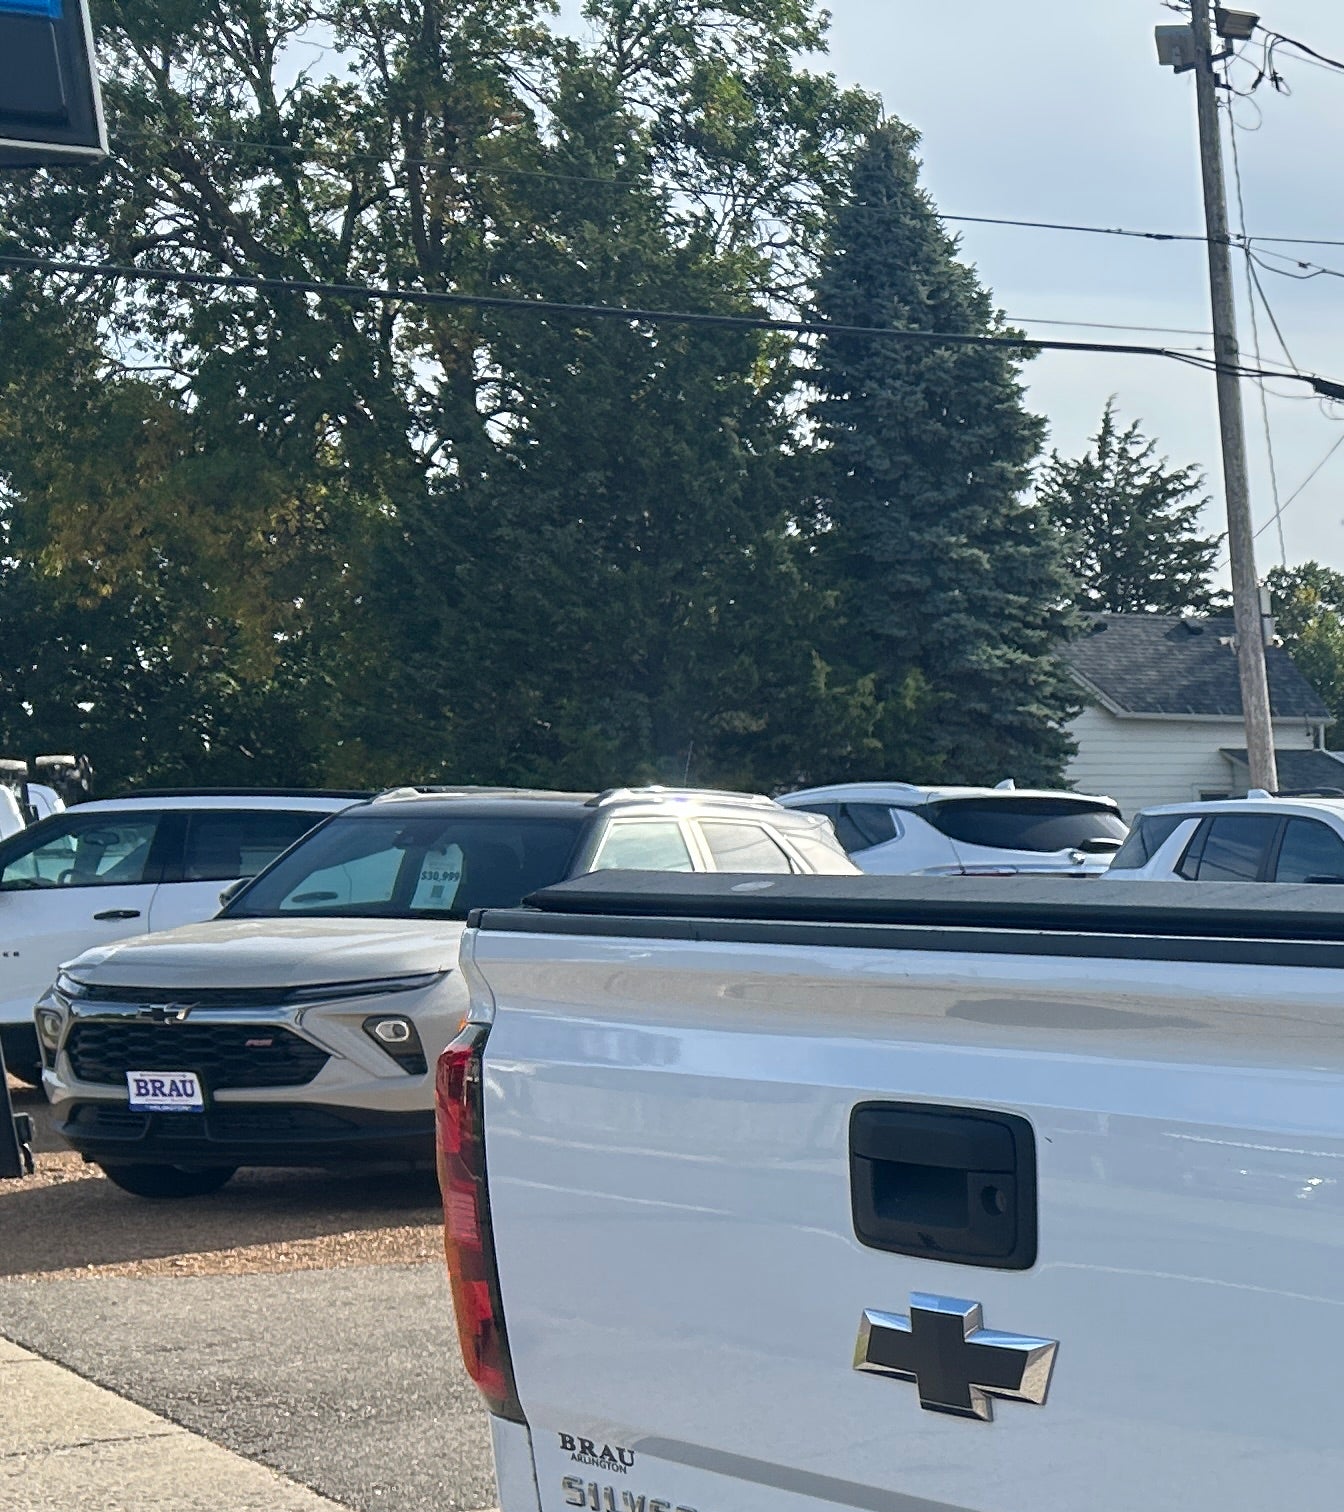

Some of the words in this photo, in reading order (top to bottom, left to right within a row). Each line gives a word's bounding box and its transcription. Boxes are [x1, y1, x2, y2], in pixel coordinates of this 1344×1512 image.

[133, 1079, 195, 1098] BRAU
[558, 1432, 635, 1467] BRAU
[571, 1452, 627, 1475] ARLINGTON
